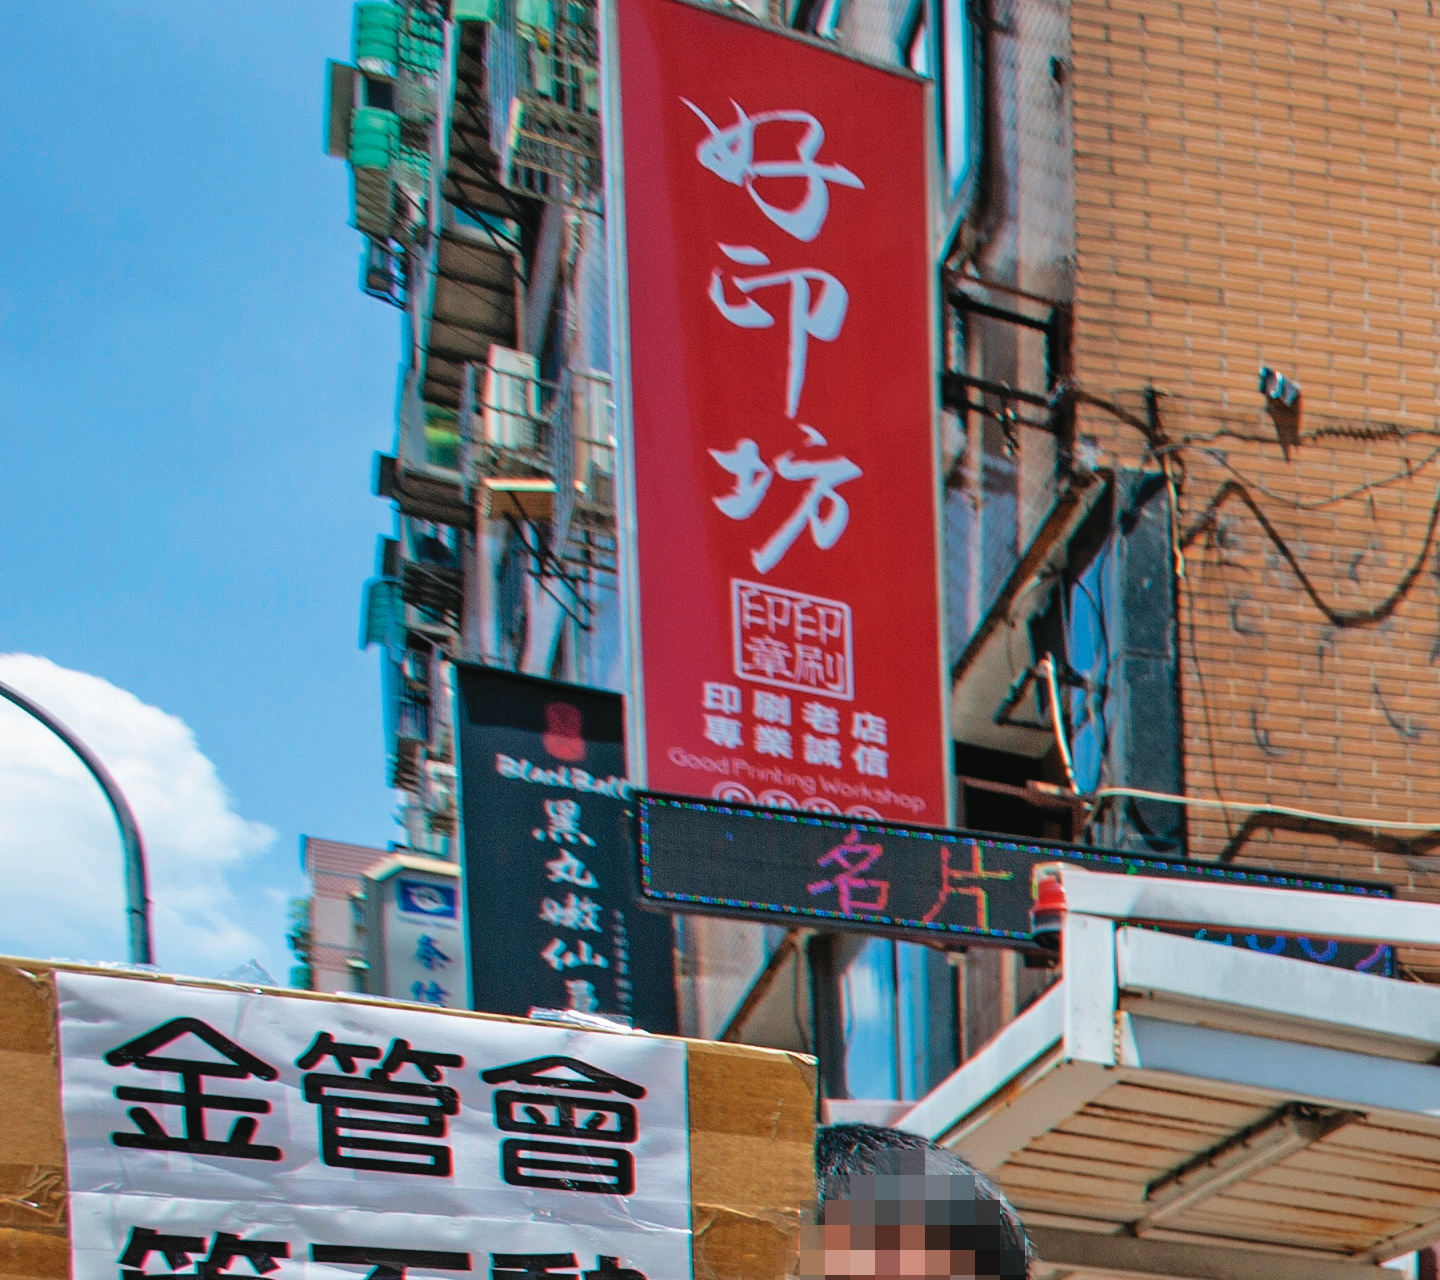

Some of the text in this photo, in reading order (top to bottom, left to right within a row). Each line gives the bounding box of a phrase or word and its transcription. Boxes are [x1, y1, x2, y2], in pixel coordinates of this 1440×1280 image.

[679, 95, 865, 574] 好印坊
[668, 747, 730, 775] Good
[733, 758, 817, 795] Printing
[819, 774, 926, 814] Workshop
[808, 828, 1012, 932] 名片
[104, 1016, 650, 1197] 金管會
